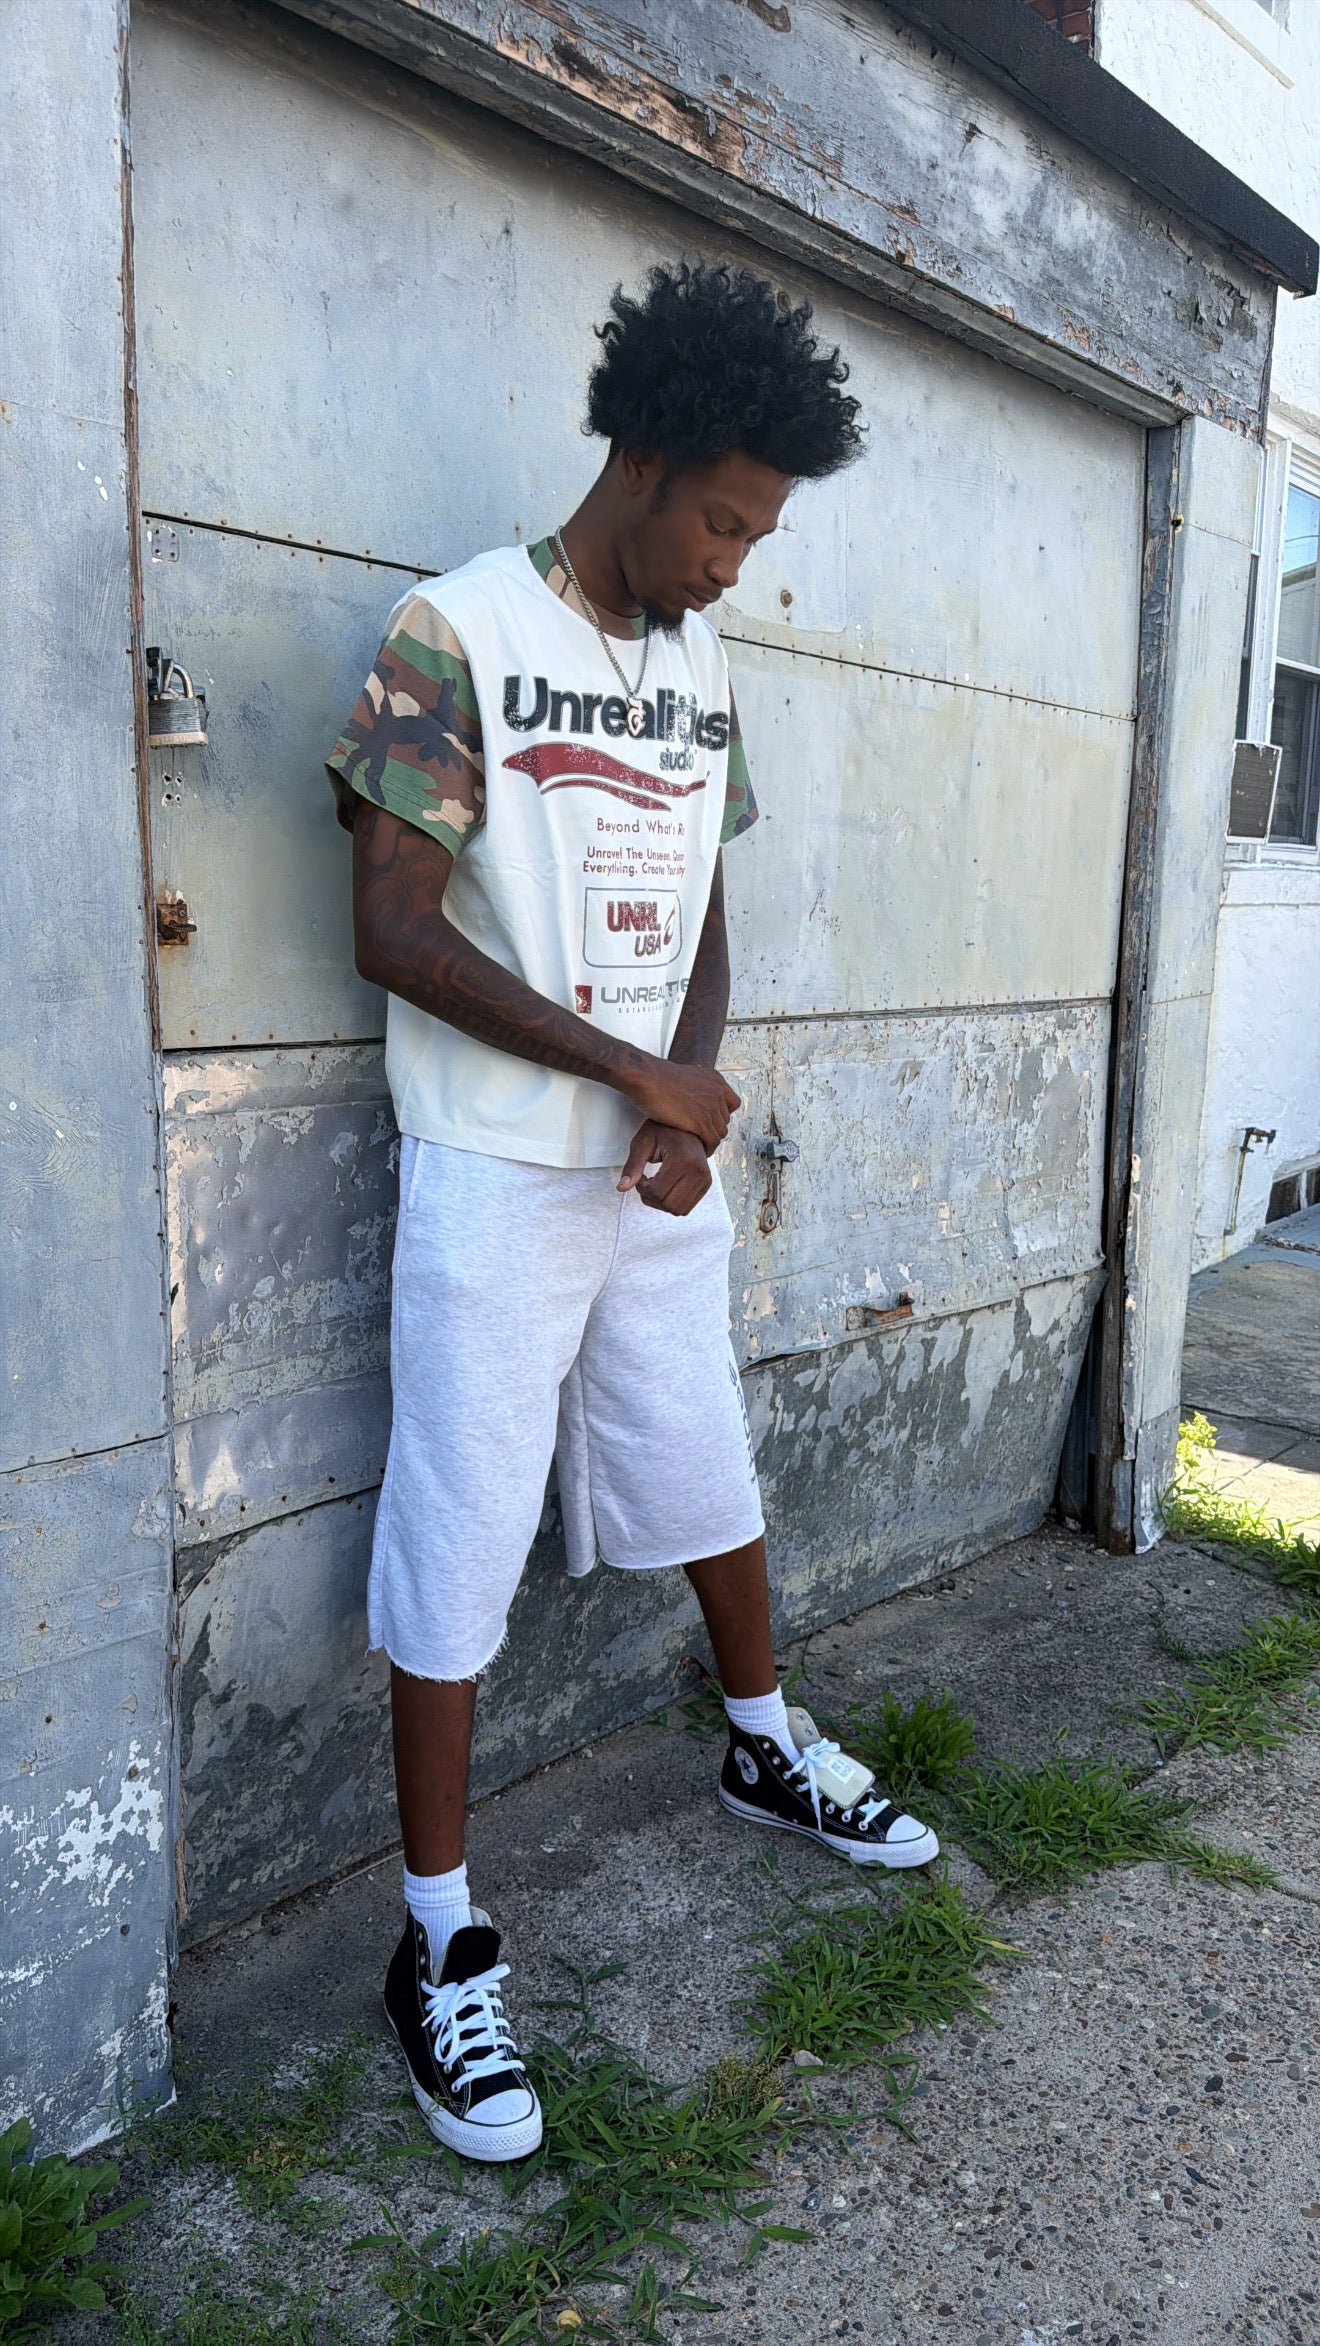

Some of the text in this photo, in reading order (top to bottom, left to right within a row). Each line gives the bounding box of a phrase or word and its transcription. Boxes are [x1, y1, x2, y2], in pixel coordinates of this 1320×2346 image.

[597, 817, 640, 836] Beyond
[646, 819, 675, 836] What's
[587, 846, 622, 860] Unravel
[626, 847, 643, 860] The
[583, 861, 637, 877] Everything.
[641, 862, 665, 875] Create
[607, 901, 661, 932] UNRL
[634, 933, 661, 957] USA
